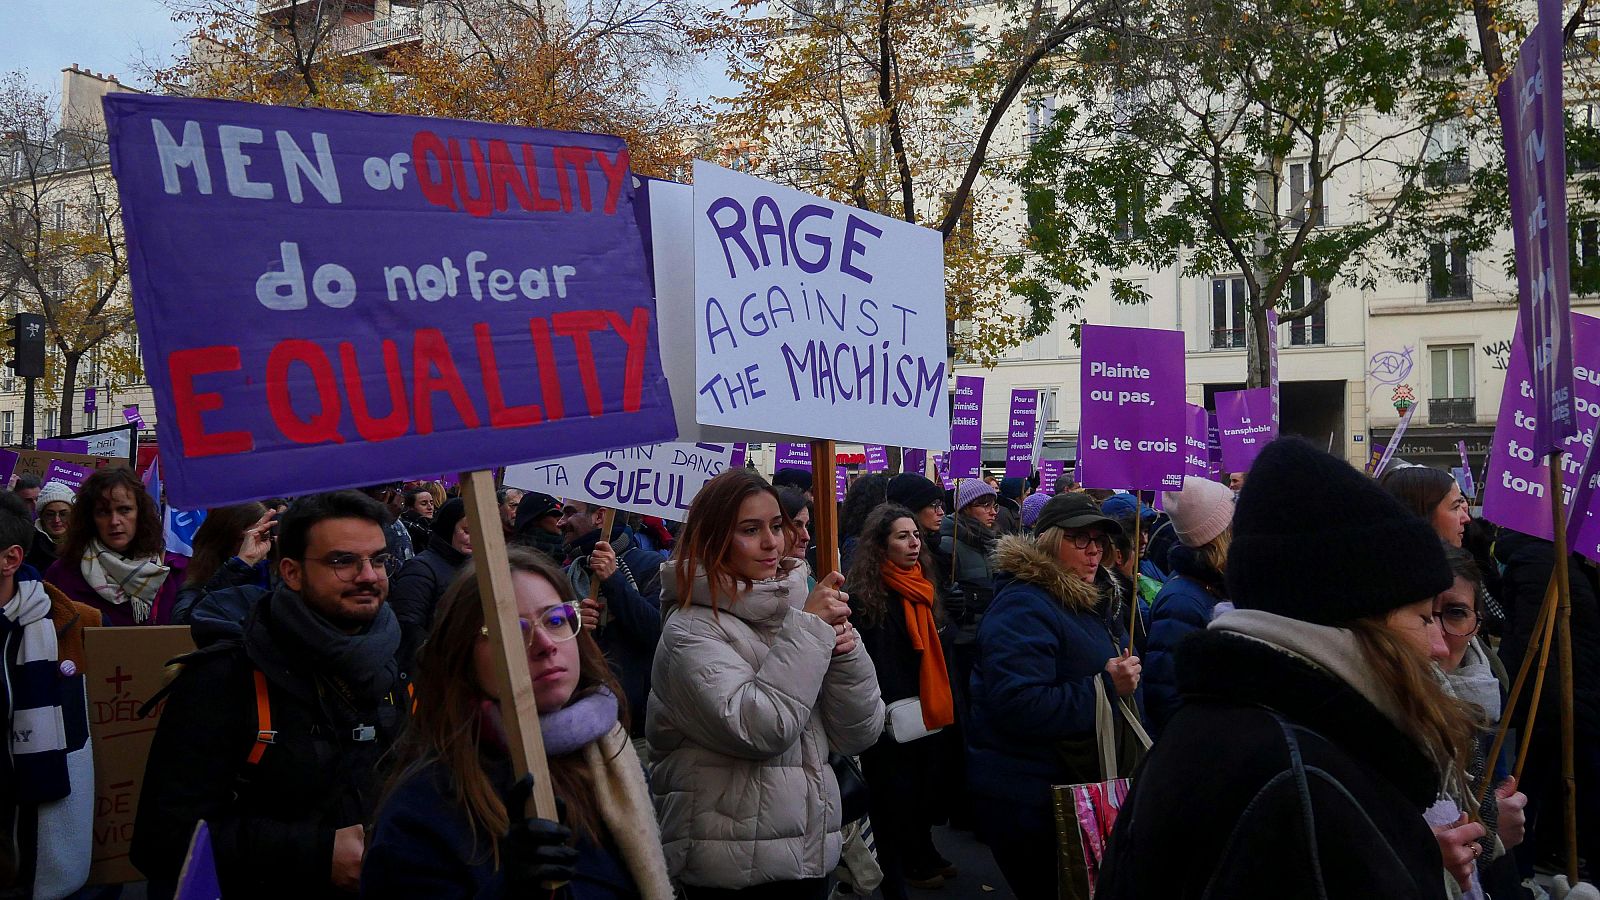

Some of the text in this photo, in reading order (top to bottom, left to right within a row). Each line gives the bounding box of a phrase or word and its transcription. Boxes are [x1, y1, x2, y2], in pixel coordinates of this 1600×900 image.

[151, 118, 631, 217] MEN of QUALITY
[706, 195, 883, 284] RAGE
[255, 240, 577, 311] do not fear
[1090, 361, 1150, 379] Plainte
[699, 363, 767, 414] THE
[1090, 390, 1156, 406] ou pas,
[1223, 424, 1271, 436] transphobie
[1241, 416, 1251, 424] La
[788, 449, 809, 457] jamais
[1090, 435, 1177, 453] Je te crois
[54, 465, 72, 475] Pour
[671, 450, 724, 478] DANS
[534, 461, 710, 511] TA GUEUL
[1502, 470, 1545, 498] ton
